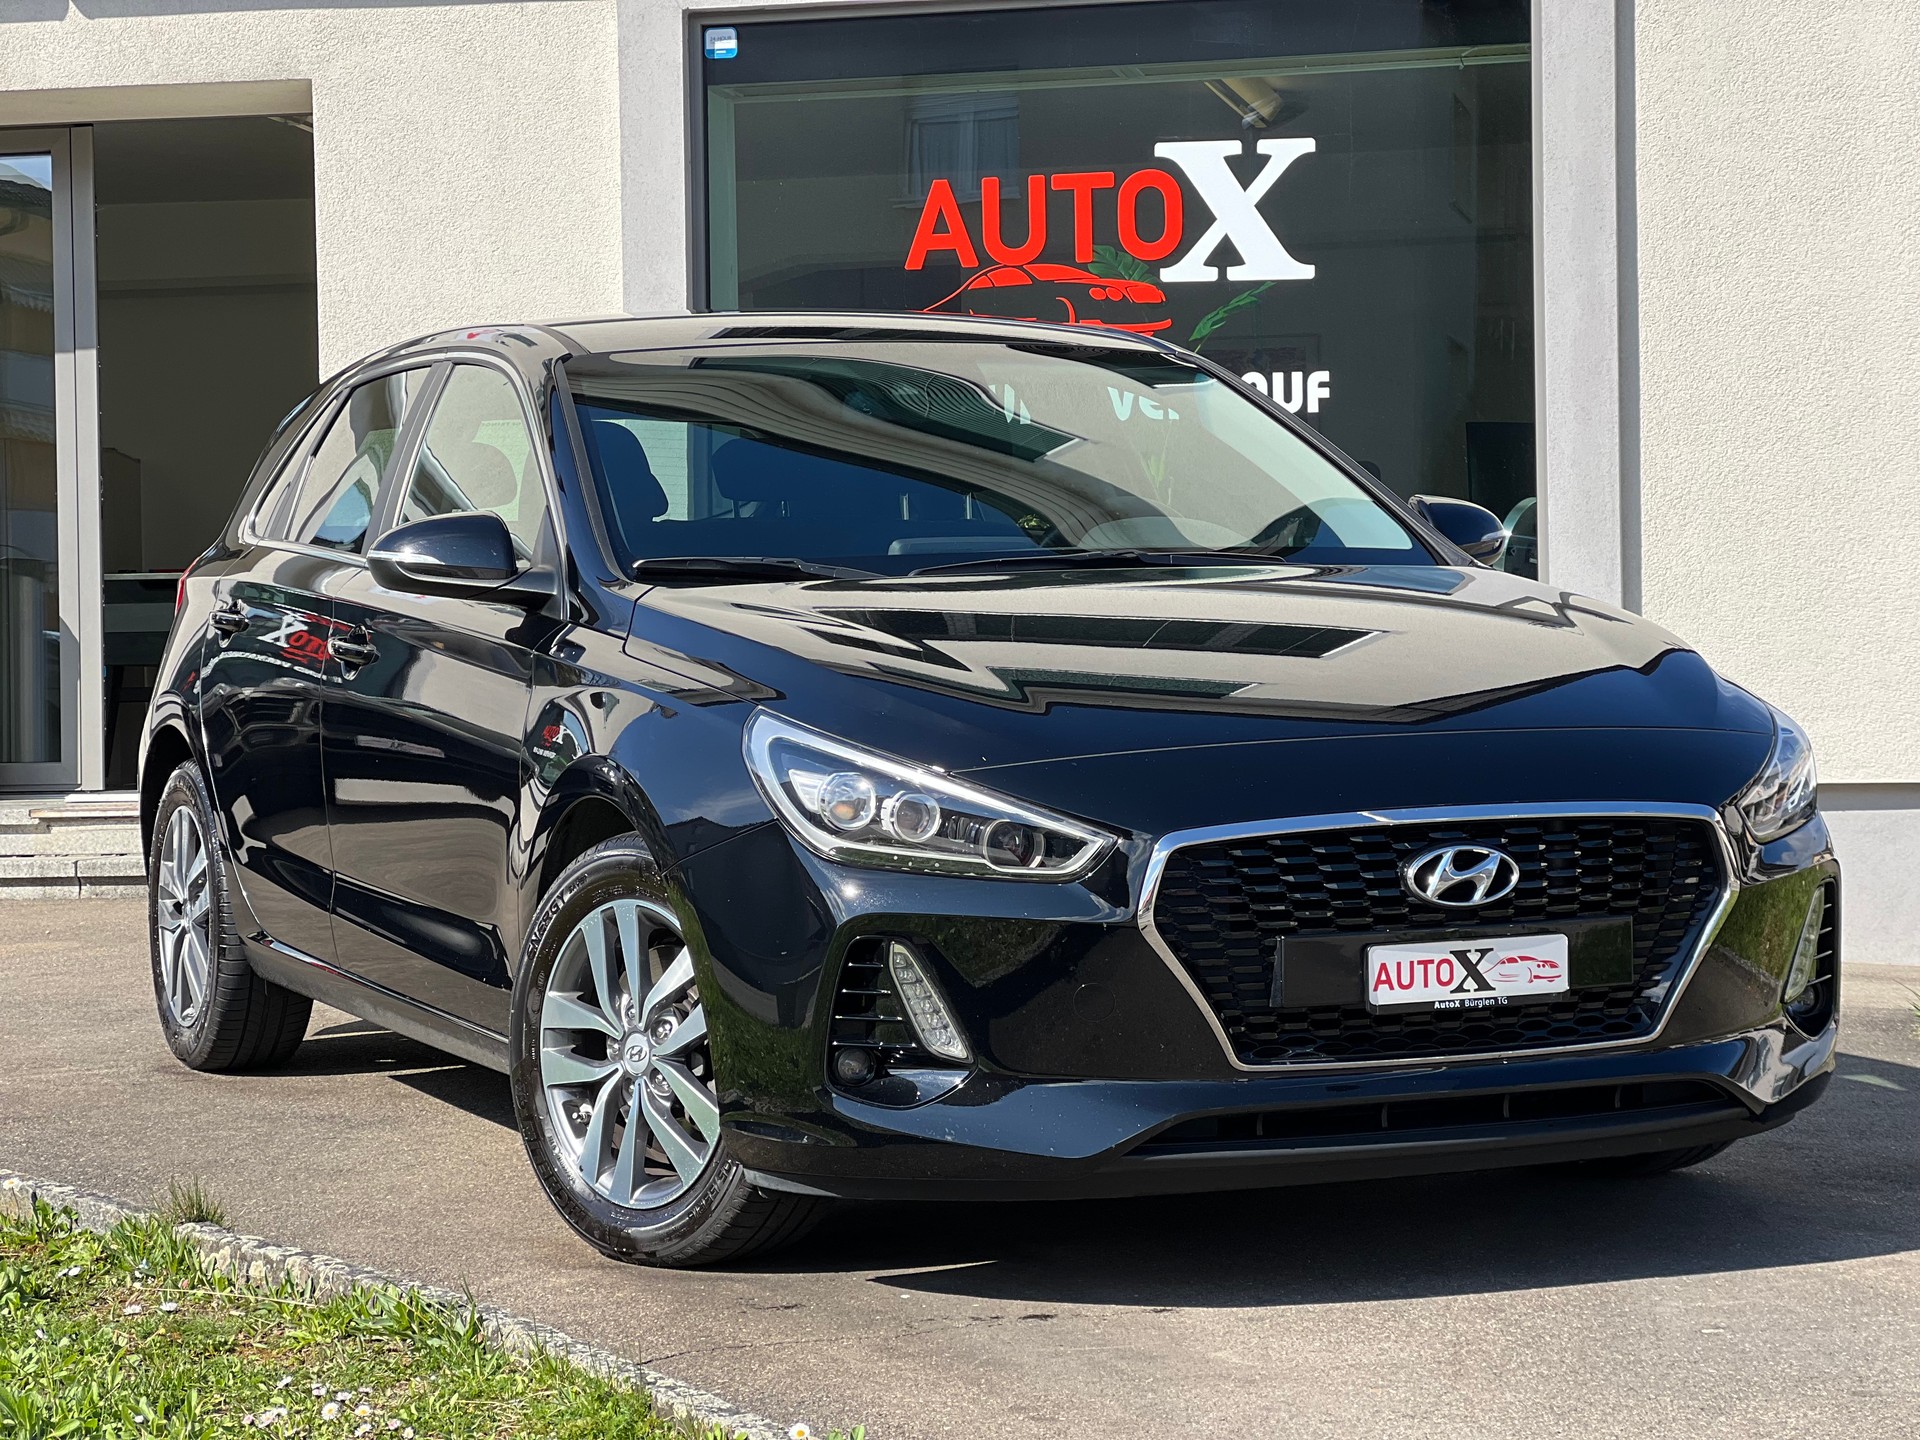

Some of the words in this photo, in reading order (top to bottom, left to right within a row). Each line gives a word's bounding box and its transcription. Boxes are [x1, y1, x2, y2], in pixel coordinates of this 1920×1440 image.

[1434, 1000, 1460, 1009] AutoX
[1464, 998, 1495, 1008] Bürglen
[1498, 996, 1508, 1005] TG
